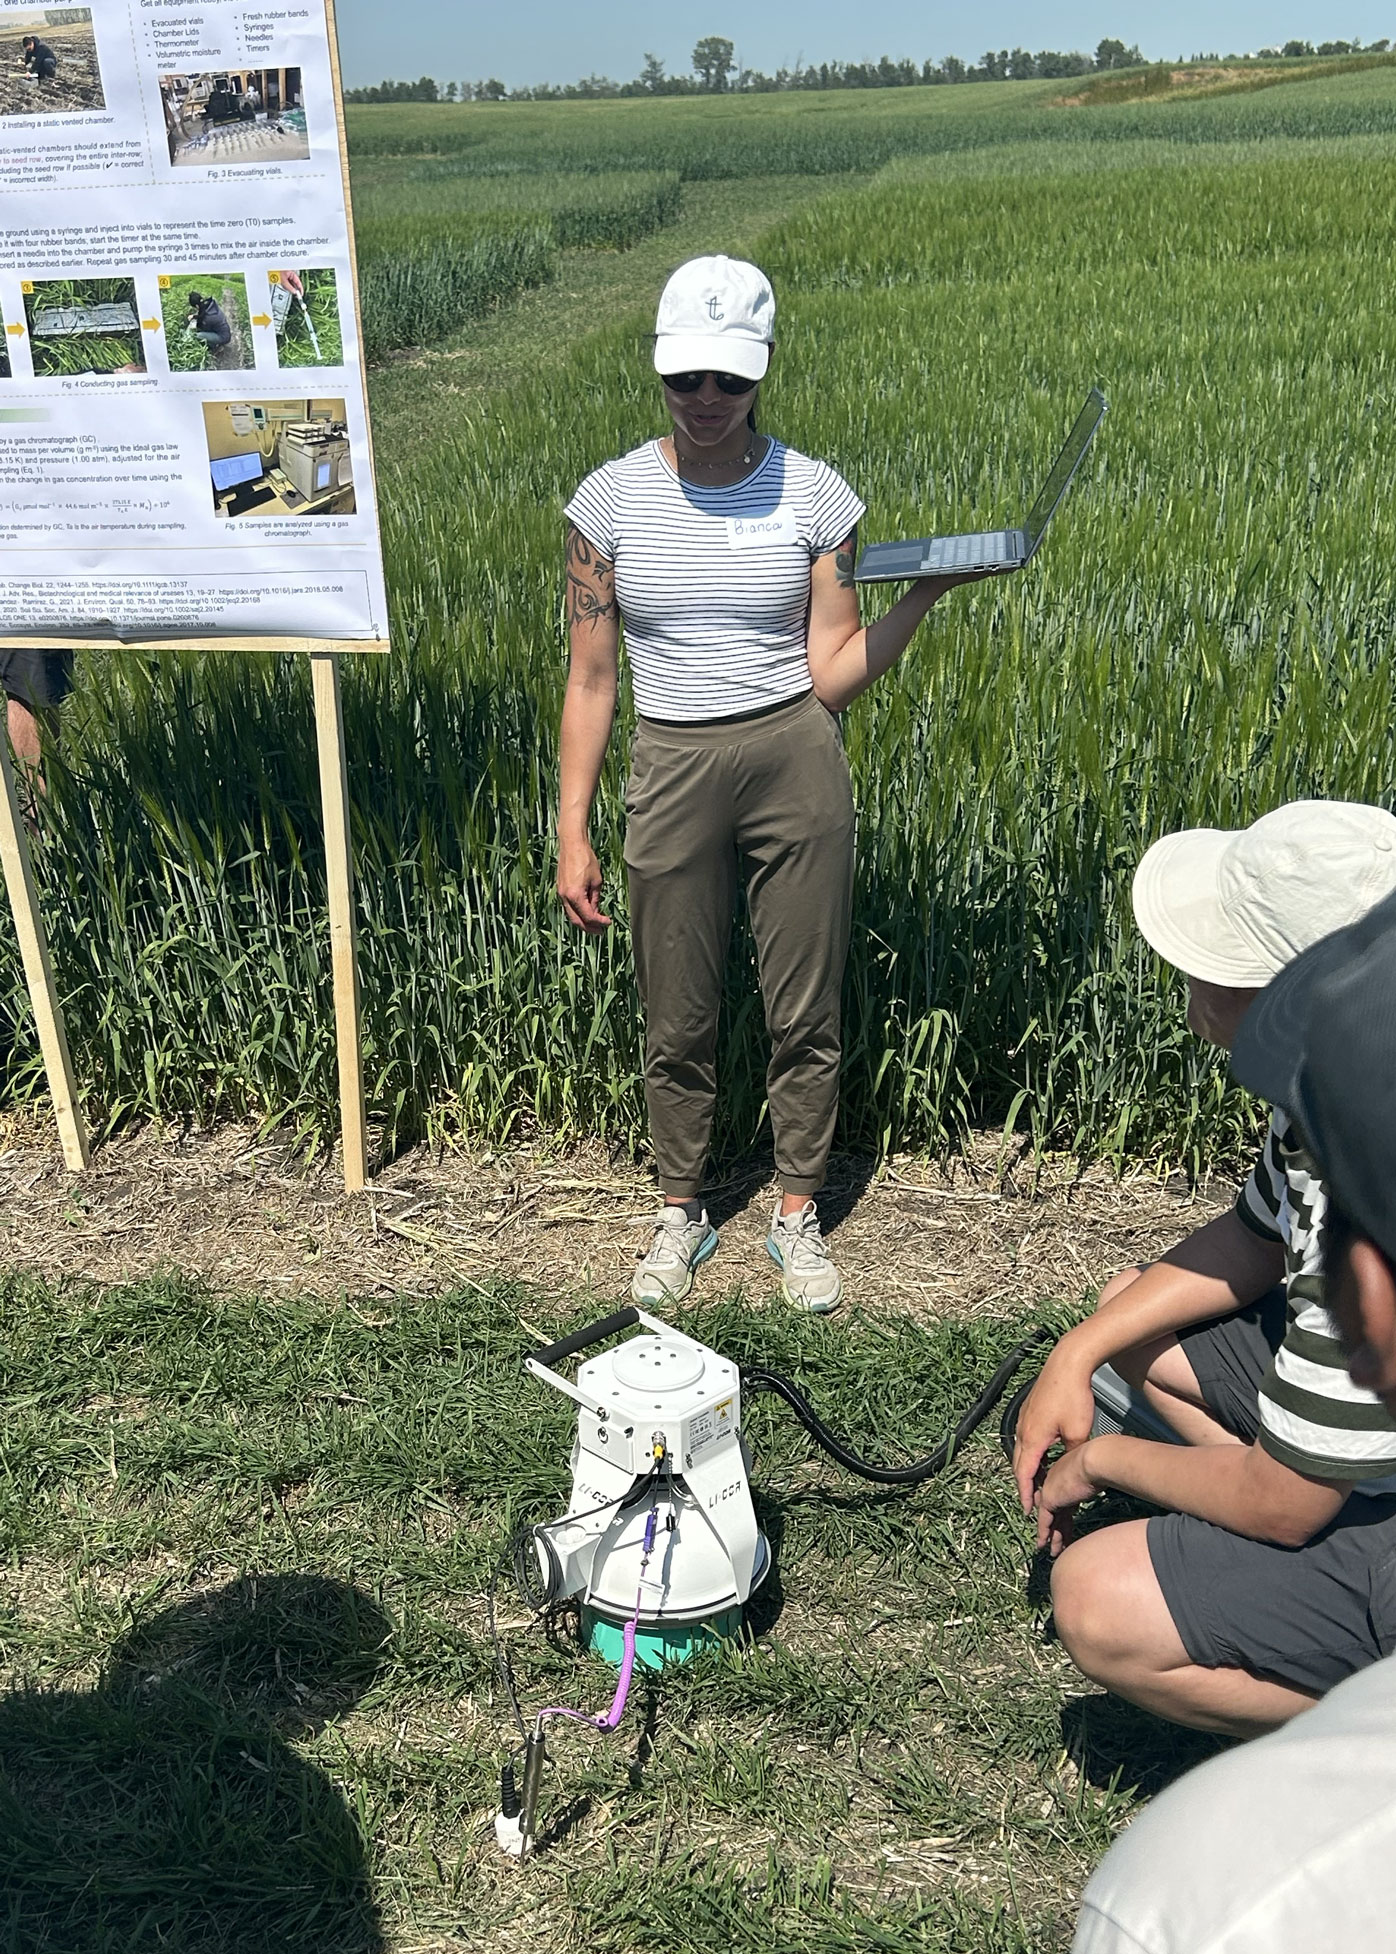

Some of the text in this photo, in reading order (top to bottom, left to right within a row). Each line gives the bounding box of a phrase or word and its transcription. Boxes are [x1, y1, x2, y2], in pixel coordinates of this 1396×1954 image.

[243, 10, 309, 21] Fresh rubber bands
[152, 17, 204, 28] Evacuated vials
[244, 23, 274, 33] Syringes
[153, 29, 184, 38] Chamber
[246, 33, 274, 41] Needles
[155, 39, 199, 48] Thermometer
[156, 48, 221, 59] Volumetric moisture
[38, 144, 72, 152] chambers
[74, 142, 98, 150] should
[99, 141, 124, 149] extend
[45, 154, 74, 163] covering
[72, 162, 100, 172] possible
[121, 160, 144, 168] correct
[5, 228, 30, 239] ground
[31, 228, 50, 237] using
[57, 227, 83, 236] syringe
[85, 225, 98, 233] and
[100, 224, 120, 234] inject
[136, 223, 153, 231] vials
[163, 221, 196, 232] represent
[10, 239, 25, 248] with
[40, 238, 63, 246] rubber
[90, 236, 106, 244] start
[23, 249, 46, 257] needle
[74, 247, 105, 255] chamber
[107, 246, 121, 254] and
[122, 247, 143, 255] pump
[158, 244, 183, 253] syringe
[259, 239, 281, 247] inside
[27, 259, 60, 268] described
[86, 257, 112, 267] Repeat
[114, 258, 128, 266] gas
[129, 255, 162, 265] sampling
[199, 253, 227, 261] minutes
[27, 436, 78, 446] chromatograph
[100, 444, 119, 453] using
[18, 476, 43, 485] change
[149, 474, 169, 483] using
[734, 519, 782, 535] Bianca
